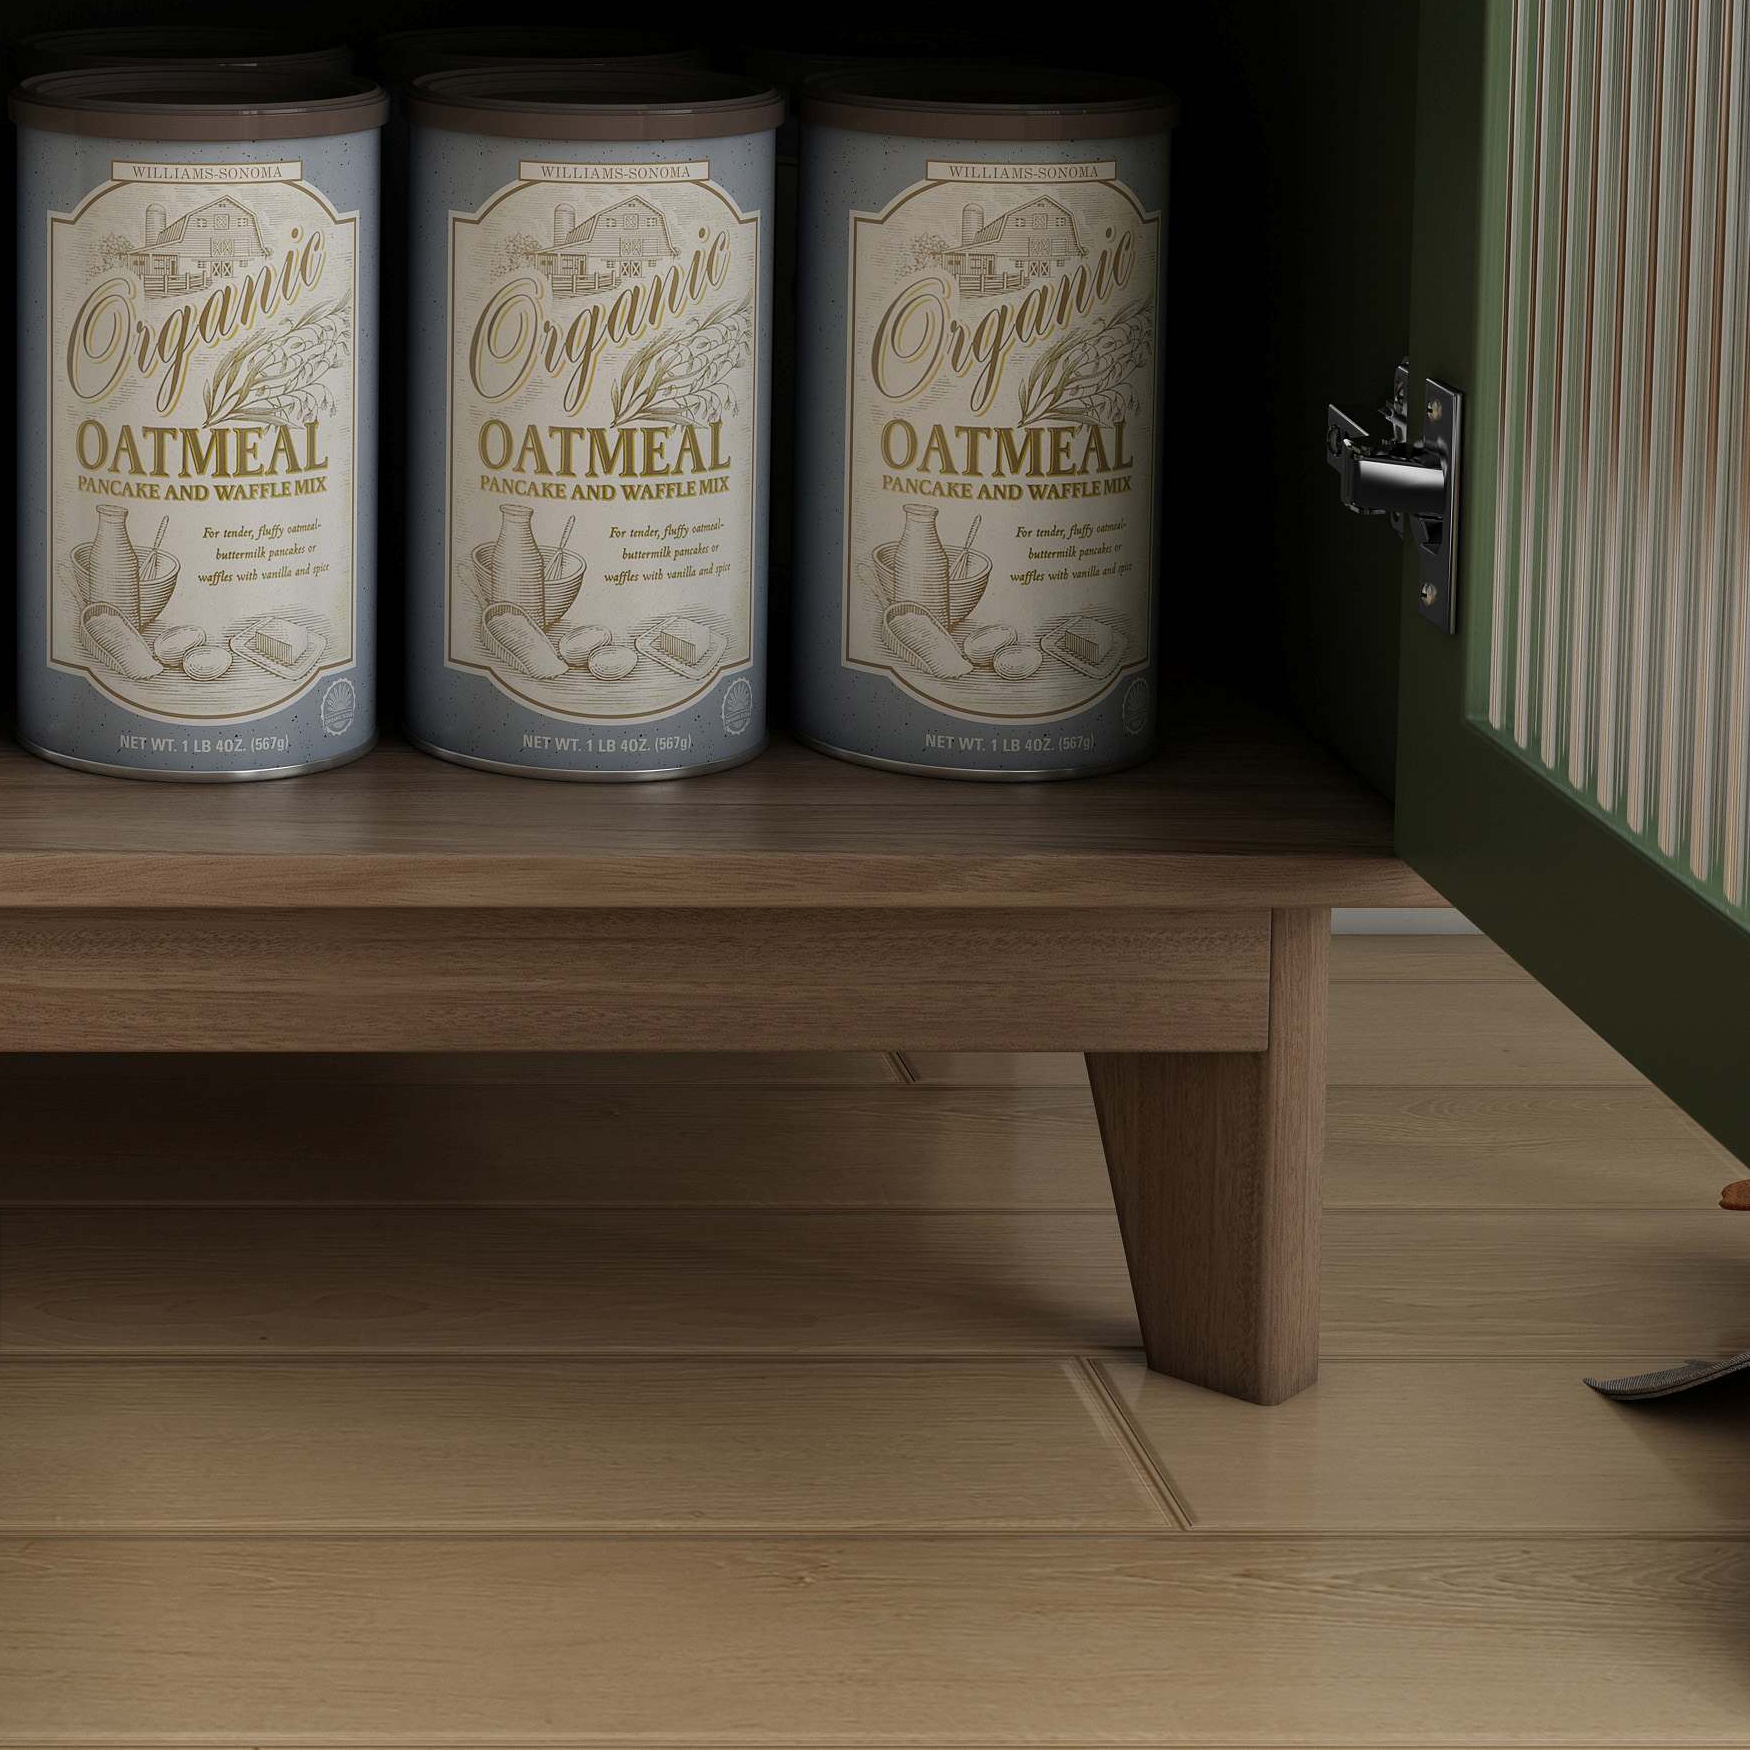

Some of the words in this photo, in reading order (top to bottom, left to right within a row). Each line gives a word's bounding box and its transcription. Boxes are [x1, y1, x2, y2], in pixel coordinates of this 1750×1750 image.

[132, 165, 282, 180] WILLIAMS-SONOMA
[541, 165, 691, 180] WILLIAMS-SONOMA
[949, 165, 1099, 180] WILLIAMS-SONOMA
[66, 227, 326, 417] Organic
[468, 227, 731, 417] Organic
[870, 227, 1136, 417] Organic
[75, 418, 330, 478] OATMEAL
[477, 418, 731, 478] OATMEAL
[879, 418, 1134, 478] OATMEAL
[78, 475, 161, 499] PANCAKE
[165, 484, 208, 500] AND
[214, 481, 293, 500] WAFFLE
[294, 475, 329, 495] MIX
[481, 475, 567, 499] PANCAKE
[572, 484, 615, 500] AND
[621, 481, 699, 500] WAFFLE
[699, 475, 732, 495] MIX
[884, 475, 973, 499] PANCAKE
[978, 484, 1021, 500] AND
[1028, 481, 1103, 500] WAFFLE
[1104, 475, 1134, 495] MIX
[202, 526, 220, 539] For
[224, 527, 254, 540] tender,
[255, 525, 285, 540] fluffy
[286, 517, 324, 533] oatmeal-
[216, 546, 267, 560] buttermilk
[268, 544, 307, 559] pancakes
[307, 543, 318, 553] or
[196, 570, 233, 586] waffles
[236, 568, 258, 581] with
[262, 567, 293, 580] vanilla
[294, 563, 311, 576] and
[312, 561, 330, 577] spice
[522, 734, 550, 750] NET
[554, 737, 583, 751] WT.
[586, 740, 593, 752] 1
[598, 740, 615, 752] LB
[654, 734, 694, 752] (567g)
